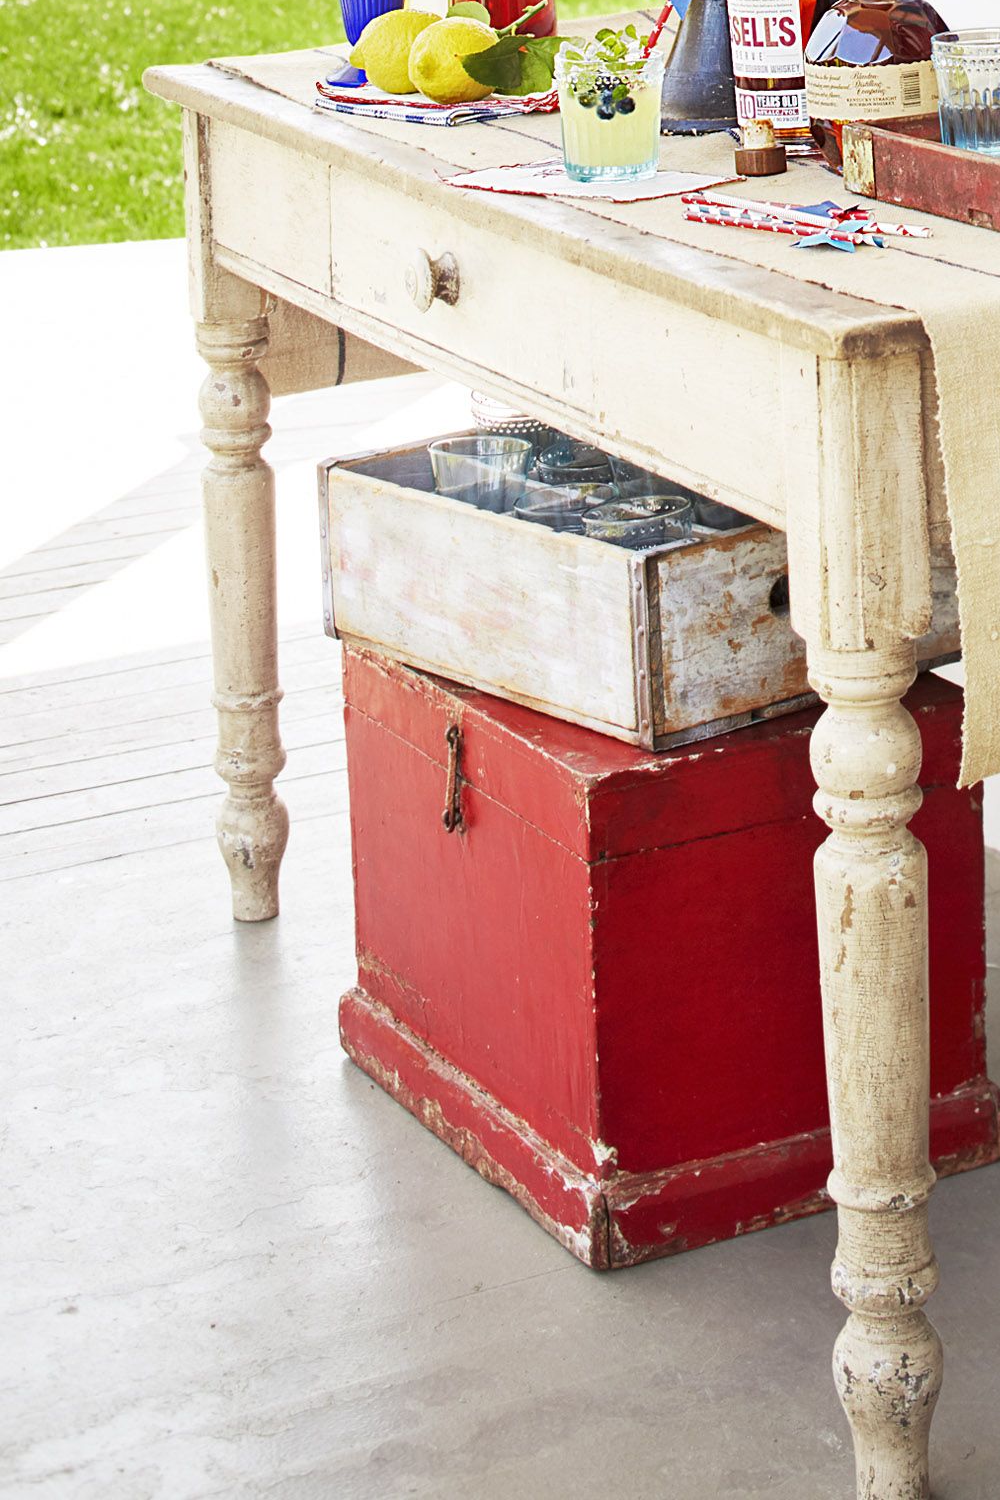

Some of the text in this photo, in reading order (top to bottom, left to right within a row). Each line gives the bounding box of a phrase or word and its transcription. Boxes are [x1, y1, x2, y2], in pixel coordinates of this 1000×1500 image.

[770, 64, 800, 73] WHISKEY
[757, 95, 781, 108] YEARS
[781, 95, 799, 107] OLD
